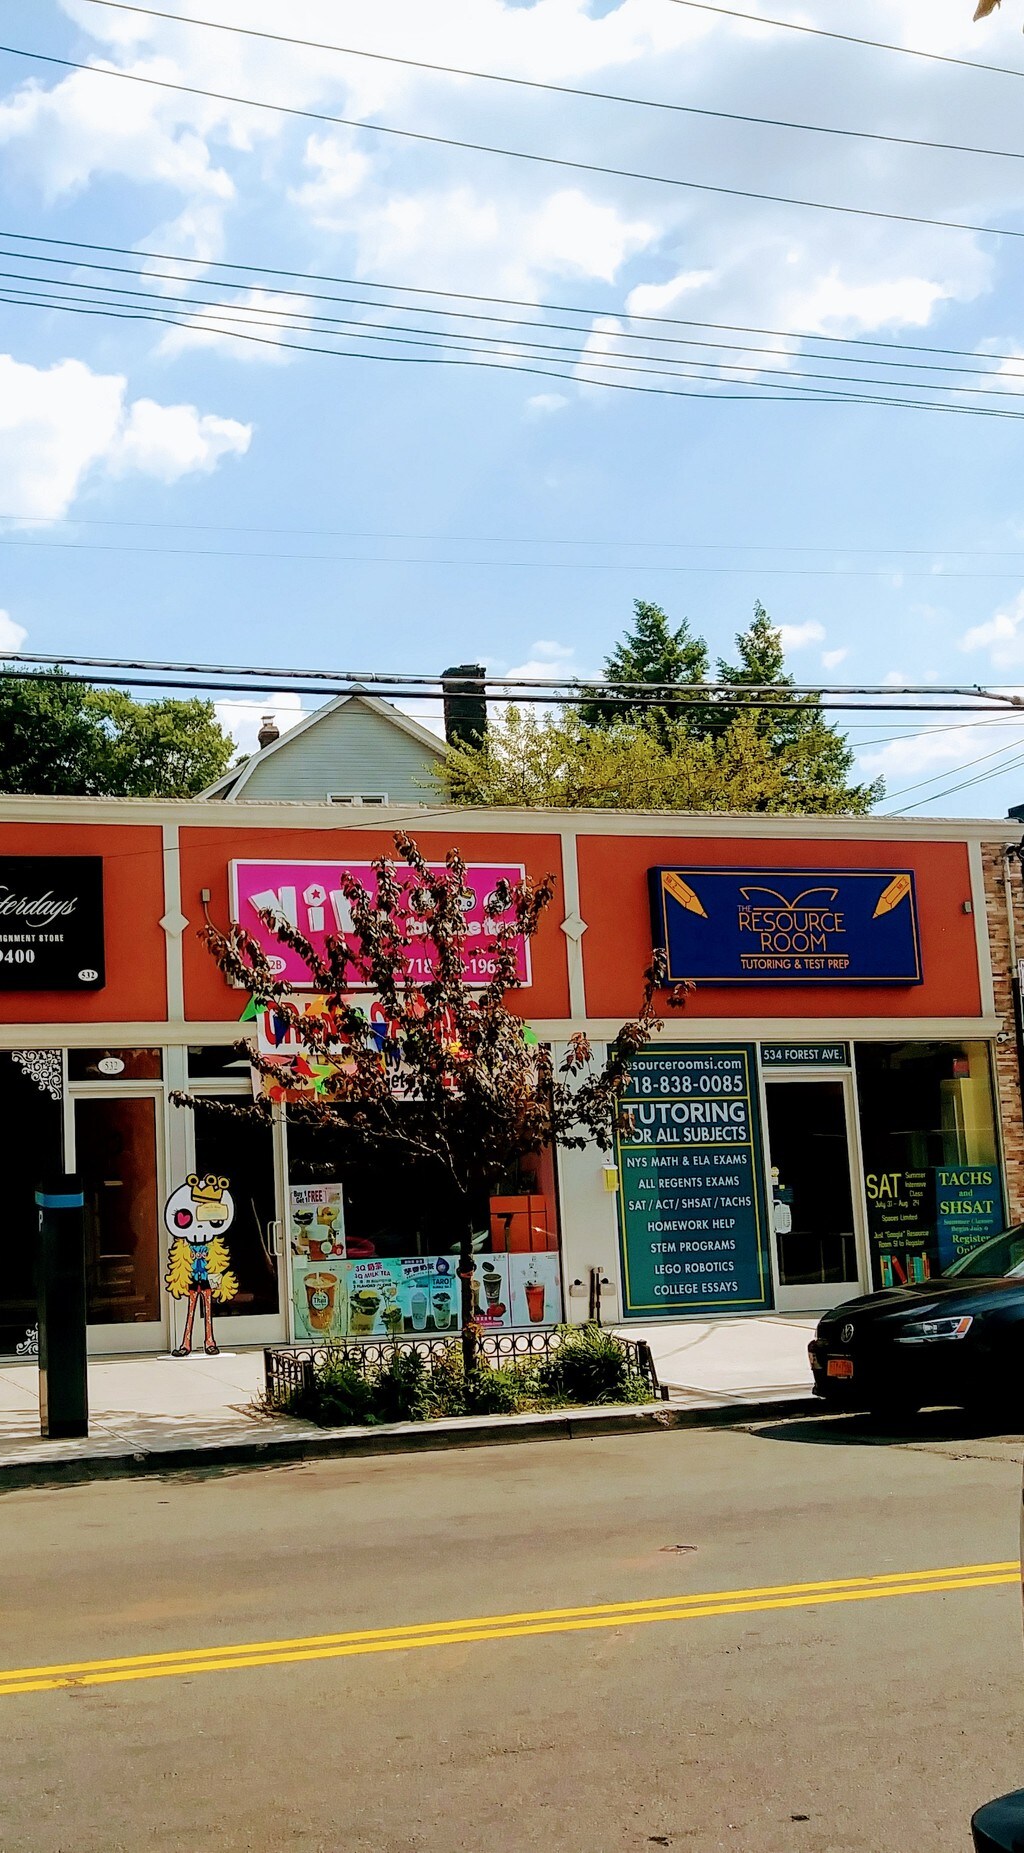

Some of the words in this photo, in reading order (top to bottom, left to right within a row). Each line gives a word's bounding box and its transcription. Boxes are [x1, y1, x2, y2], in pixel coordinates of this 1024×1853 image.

[739, 912, 846, 932] RESOURCE
[39, 933, 64, 942] STORE
[761, 932, 827, 952] ROOM
[740, 959, 791, 970] TUTORING
[794, 959, 802, 970] &
[804, 959, 824, 969] TEST
[828, 959, 850, 969] PREP
[81, 971, 96, 980] 532
[763, 1050, 782, 1060] 534
[784, 1049, 819, 1060] FOREST
[821, 1049, 843, 1060] AVE.
[104, 1061, 118, 1071] 532
[629, 1075, 743, 1094] 18-838-0085
[623, 1102, 746, 1124] TUTORING
[625, 1128, 653, 1143] OR
[656, 1127, 680, 1143] ALL
[683, 1126, 747, 1142] SUBJECTS
[626, 1157, 648, 1168] NYS
[651, 1156, 679, 1167] MATH
[682, 1155, 690, 1166] &
[693, 1155, 711, 1166] ELA
[713, 1154, 747, 1165] EXAMS
[638, 1178, 655, 1189] ALL
[658, 1177, 703, 1188] REGENTS
[705, 1176, 740, 1187] EXAMS
[938, 1171, 992, 1186] TACHS
[866, 1173, 902, 1199] SAT
[958, 1189, 973, 1197] and
[293, 1190, 304, 1198] Buy
[308, 1190, 323, 1202] FREE
[628, 1200, 646, 1211] SAT
[681, 1198, 712, 1209] SHSAT
[720, 1196, 752, 1207] TACHS
[898, 1200, 908, 1208] Aug
[940, 1200, 993, 1215] SHSAT
[647, 1219, 709, 1232] HOMEWORK
[712, 1218, 736, 1229] HELP
[650, 1242, 676, 1253] STEM
[679, 1239, 736, 1252] PROGRAMS
[952, 1234, 991, 1245] Register
[655, 1264, 681, 1275] LEGO
[684, 1261, 734, 1273] ROBOTICS
[654, 1283, 698, 1296] COLLEGE
[701, 1281, 738, 1293] ESSAYS
